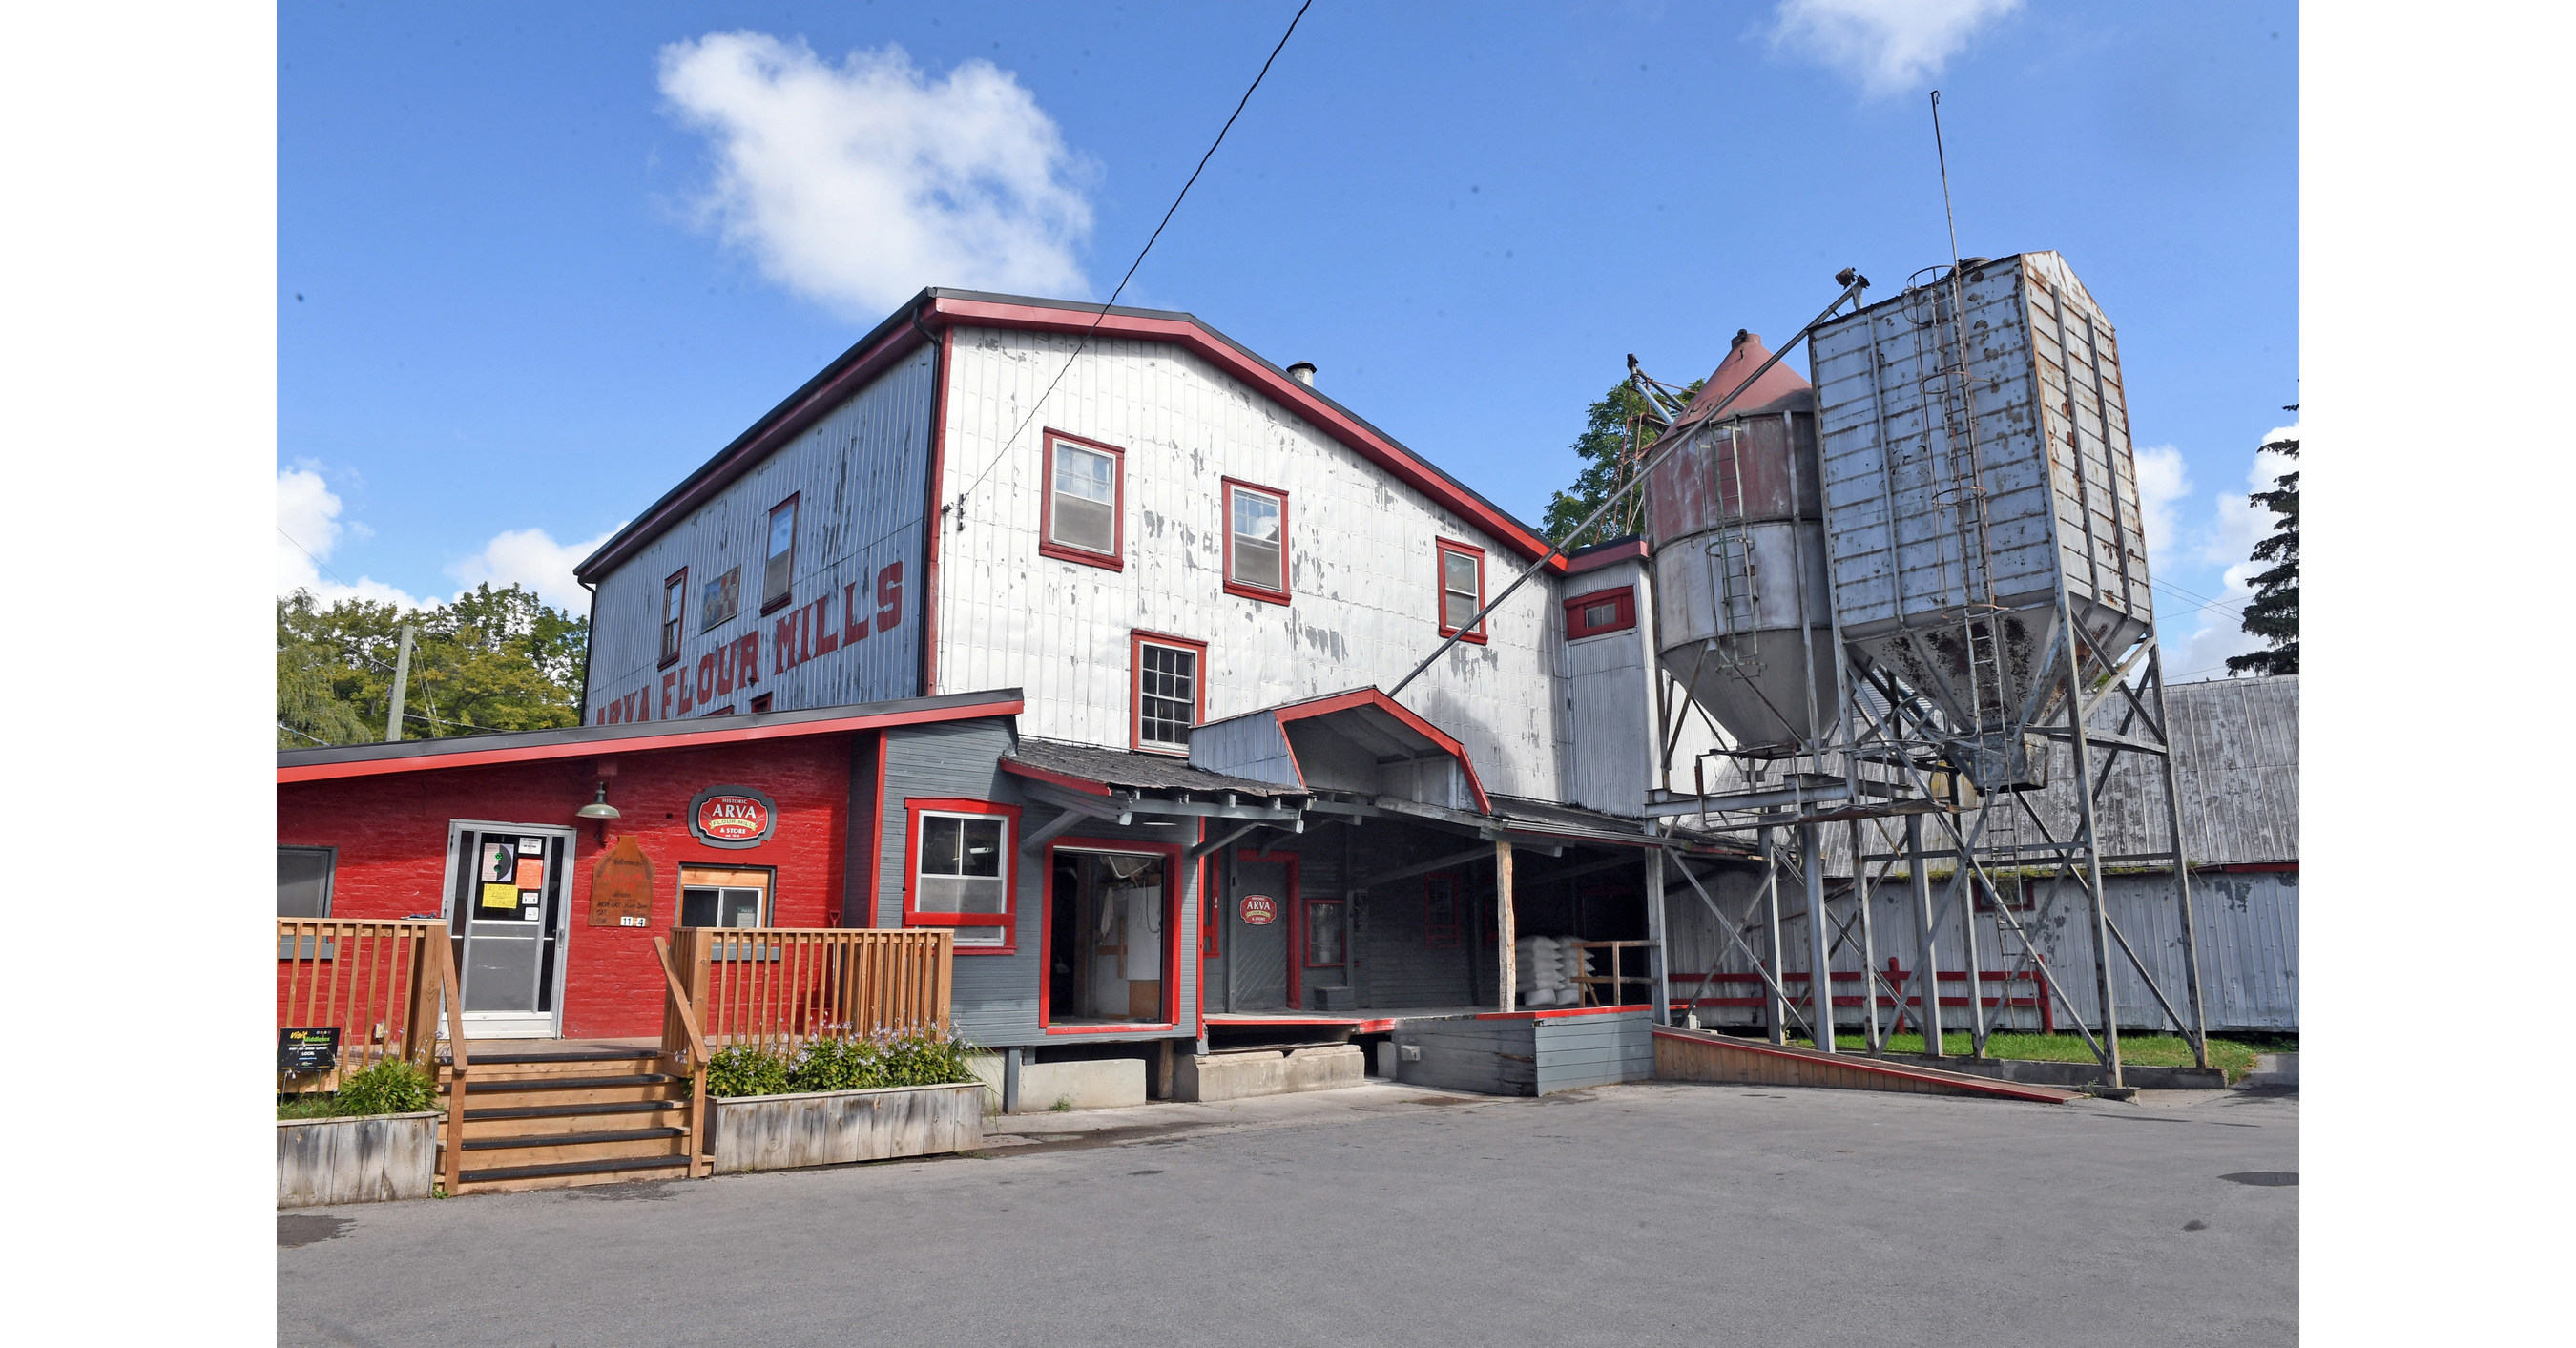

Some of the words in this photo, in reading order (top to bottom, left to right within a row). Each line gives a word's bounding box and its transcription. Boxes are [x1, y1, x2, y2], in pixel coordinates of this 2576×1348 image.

[661, 631, 760, 720] FLOUR
[774, 561, 904, 675] MILLS
[712, 803, 757, 819] ARVA
[737, 819, 753, 828] MILL
[1247, 901, 1270, 910] ARVA
[290, 1030, 308, 1039] Visit
